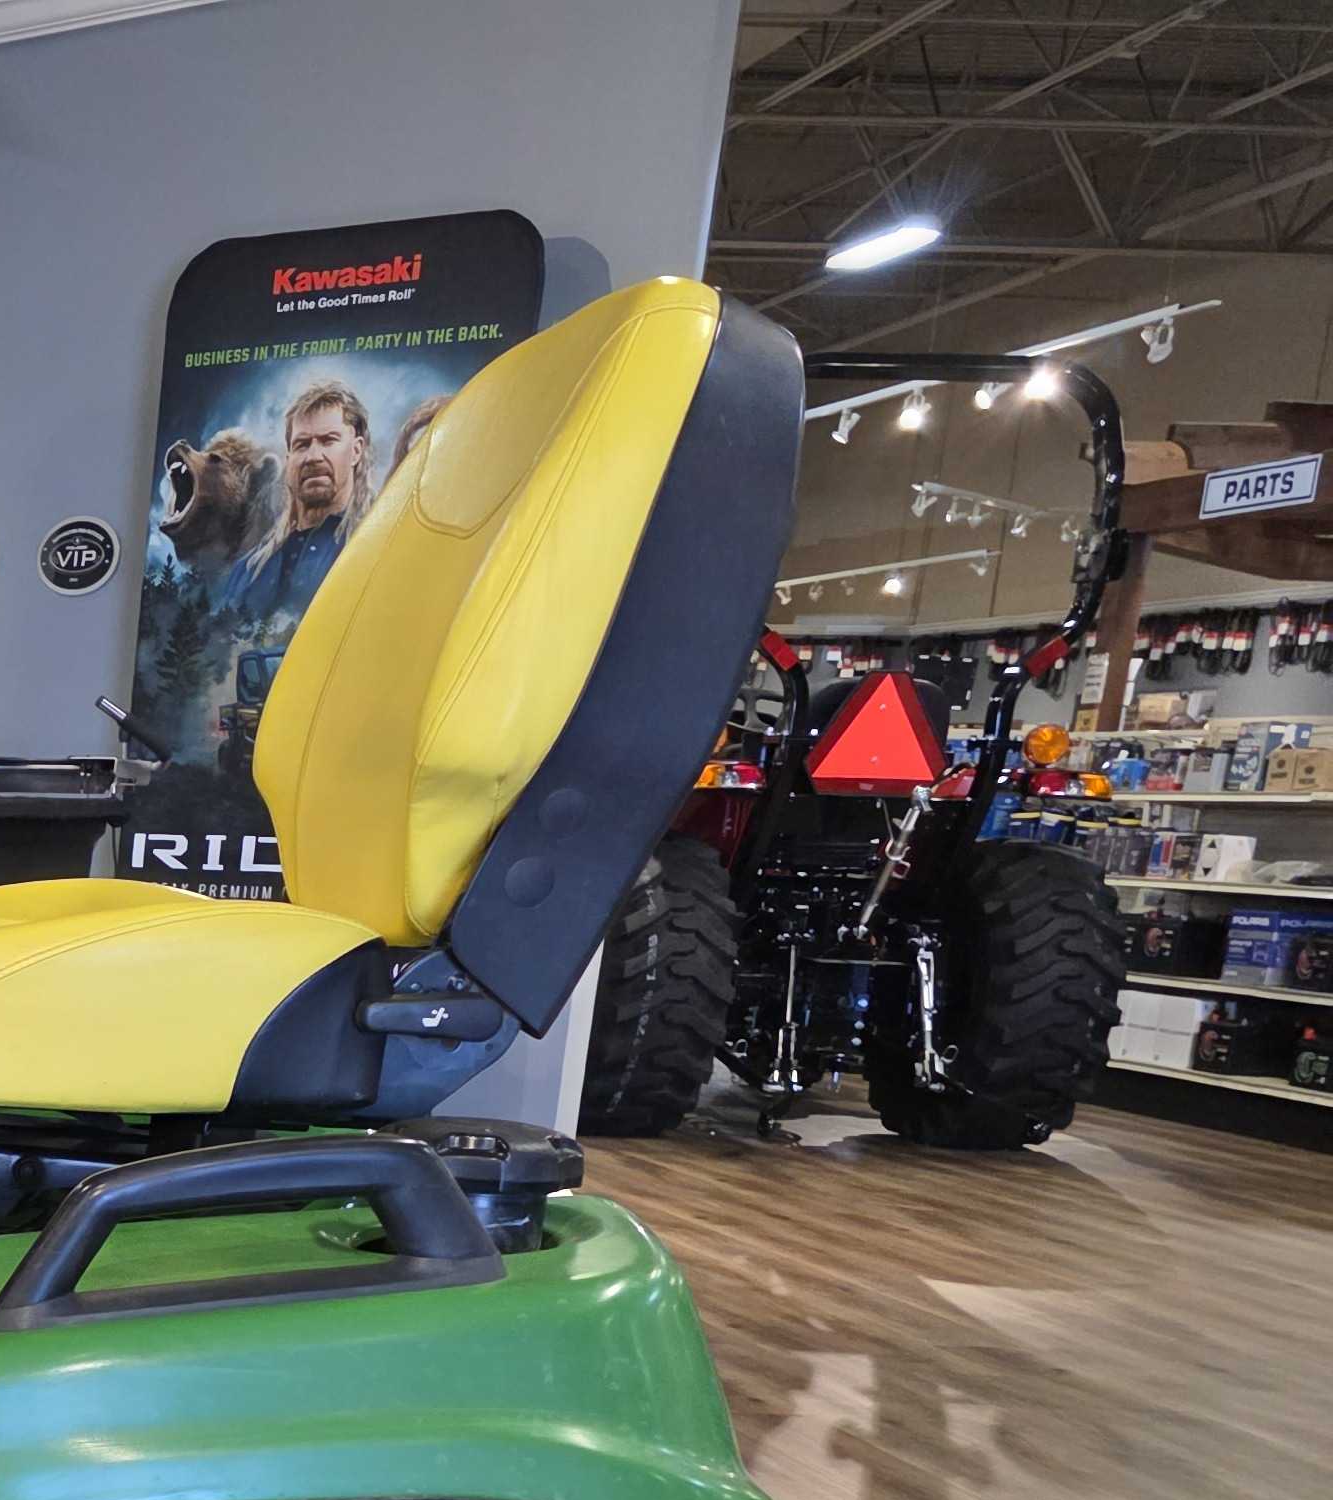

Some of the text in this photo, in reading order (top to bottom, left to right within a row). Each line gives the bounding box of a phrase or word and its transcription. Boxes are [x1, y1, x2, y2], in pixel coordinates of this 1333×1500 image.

[272, 252, 423, 295] Kawasaki
[276, 301, 295, 313] Let
[297, 298, 316, 311] the
[317, 294, 349, 309] Good
[351, 291, 386, 306] Times
[185, 323, 504, 368] BUSINESS IN THE FRONT. PARTY IN THE BACK.
[1223, 471, 1294, 504] PARTS
[56, 549, 97, 568] VIP
[198, 883, 273, 900] PREMIUM
